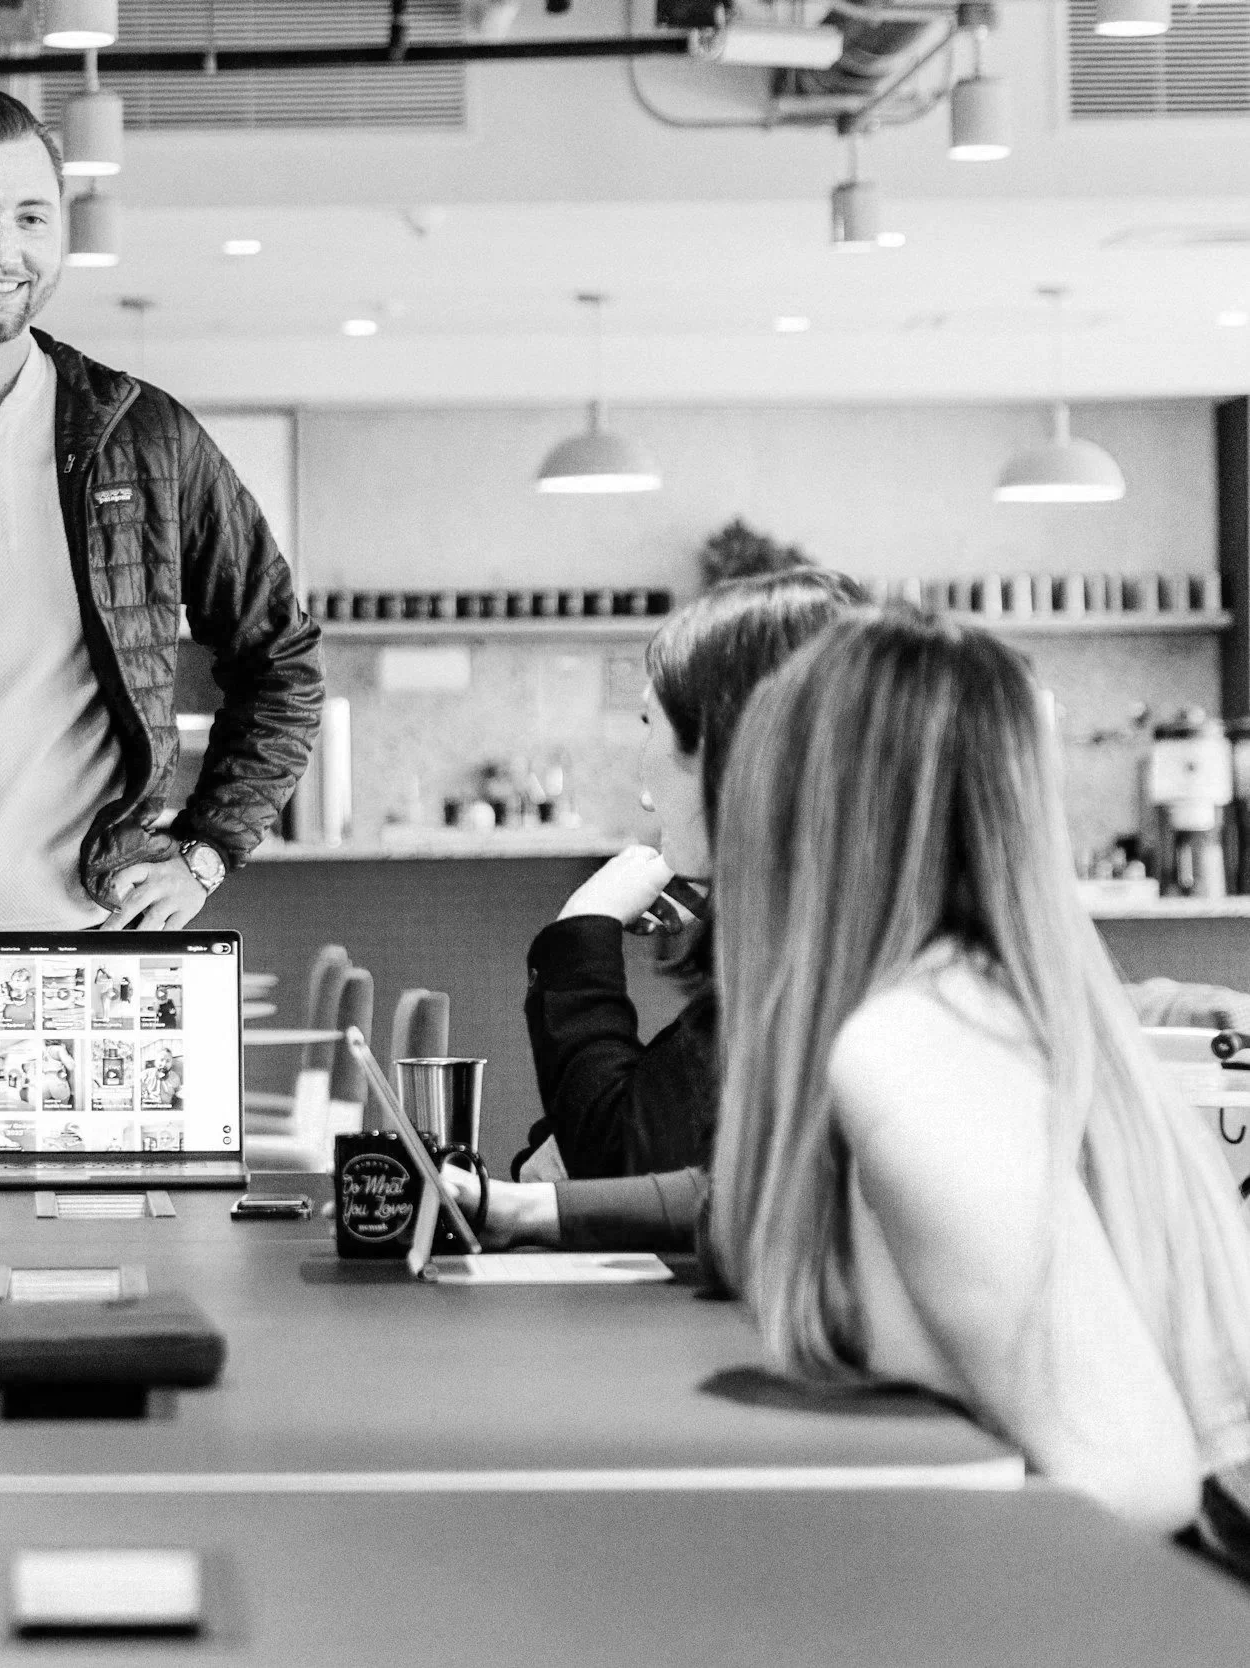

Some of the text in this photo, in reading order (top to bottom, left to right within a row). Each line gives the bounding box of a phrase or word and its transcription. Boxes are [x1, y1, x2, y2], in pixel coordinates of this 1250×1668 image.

[343, 1173, 408, 1196] Do What
[343, 1194, 412, 1224] You Love
